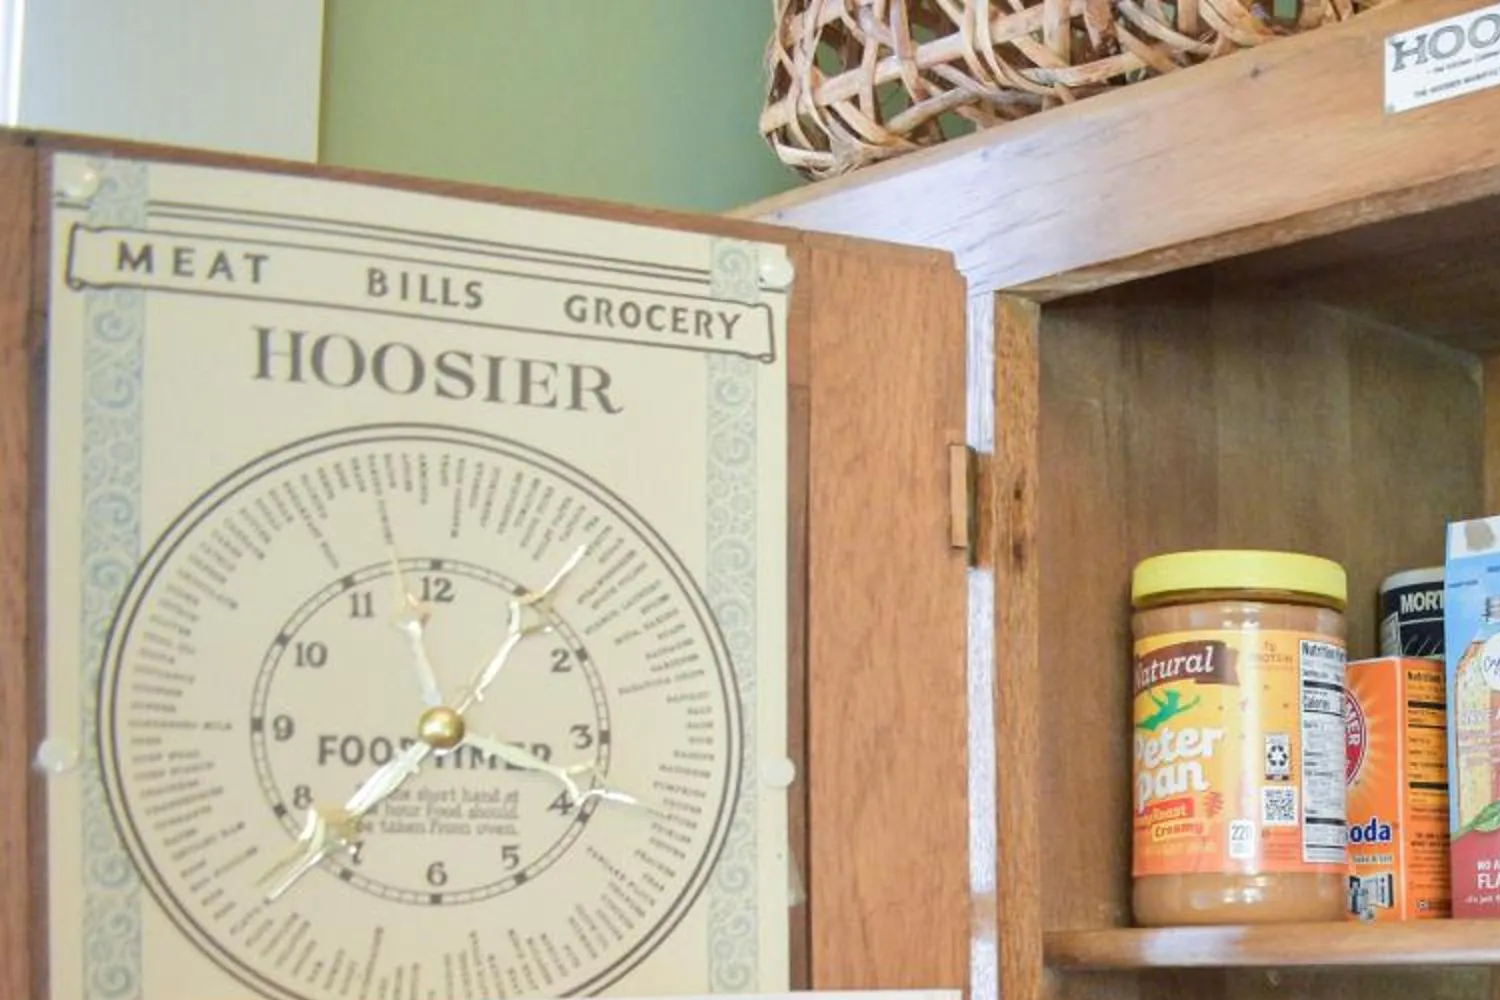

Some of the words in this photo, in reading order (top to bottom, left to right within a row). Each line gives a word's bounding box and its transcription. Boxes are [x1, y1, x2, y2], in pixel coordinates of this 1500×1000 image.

[116, 240, 270, 285] MEAT
[366, 267, 485, 309] BILLS
[563, 294, 742, 340] GROCERY
[251, 325, 625, 415] HOOSIER
[420, 576, 455, 603] 12
[1400, 590, 1443, 614] MORT
[350, 592, 375, 618] 11
[295, 642, 328, 669] 10
[551, 648, 572, 673] 2
[272, 715, 295, 741] 9
[570, 724, 593, 750] 3
[293, 785, 315, 810] 8
[547, 790, 574, 817] 4
[1345, 817, 1392, 843] oda
[501, 846, 520, 870] 5
[426, 862, 448, 886] 6
